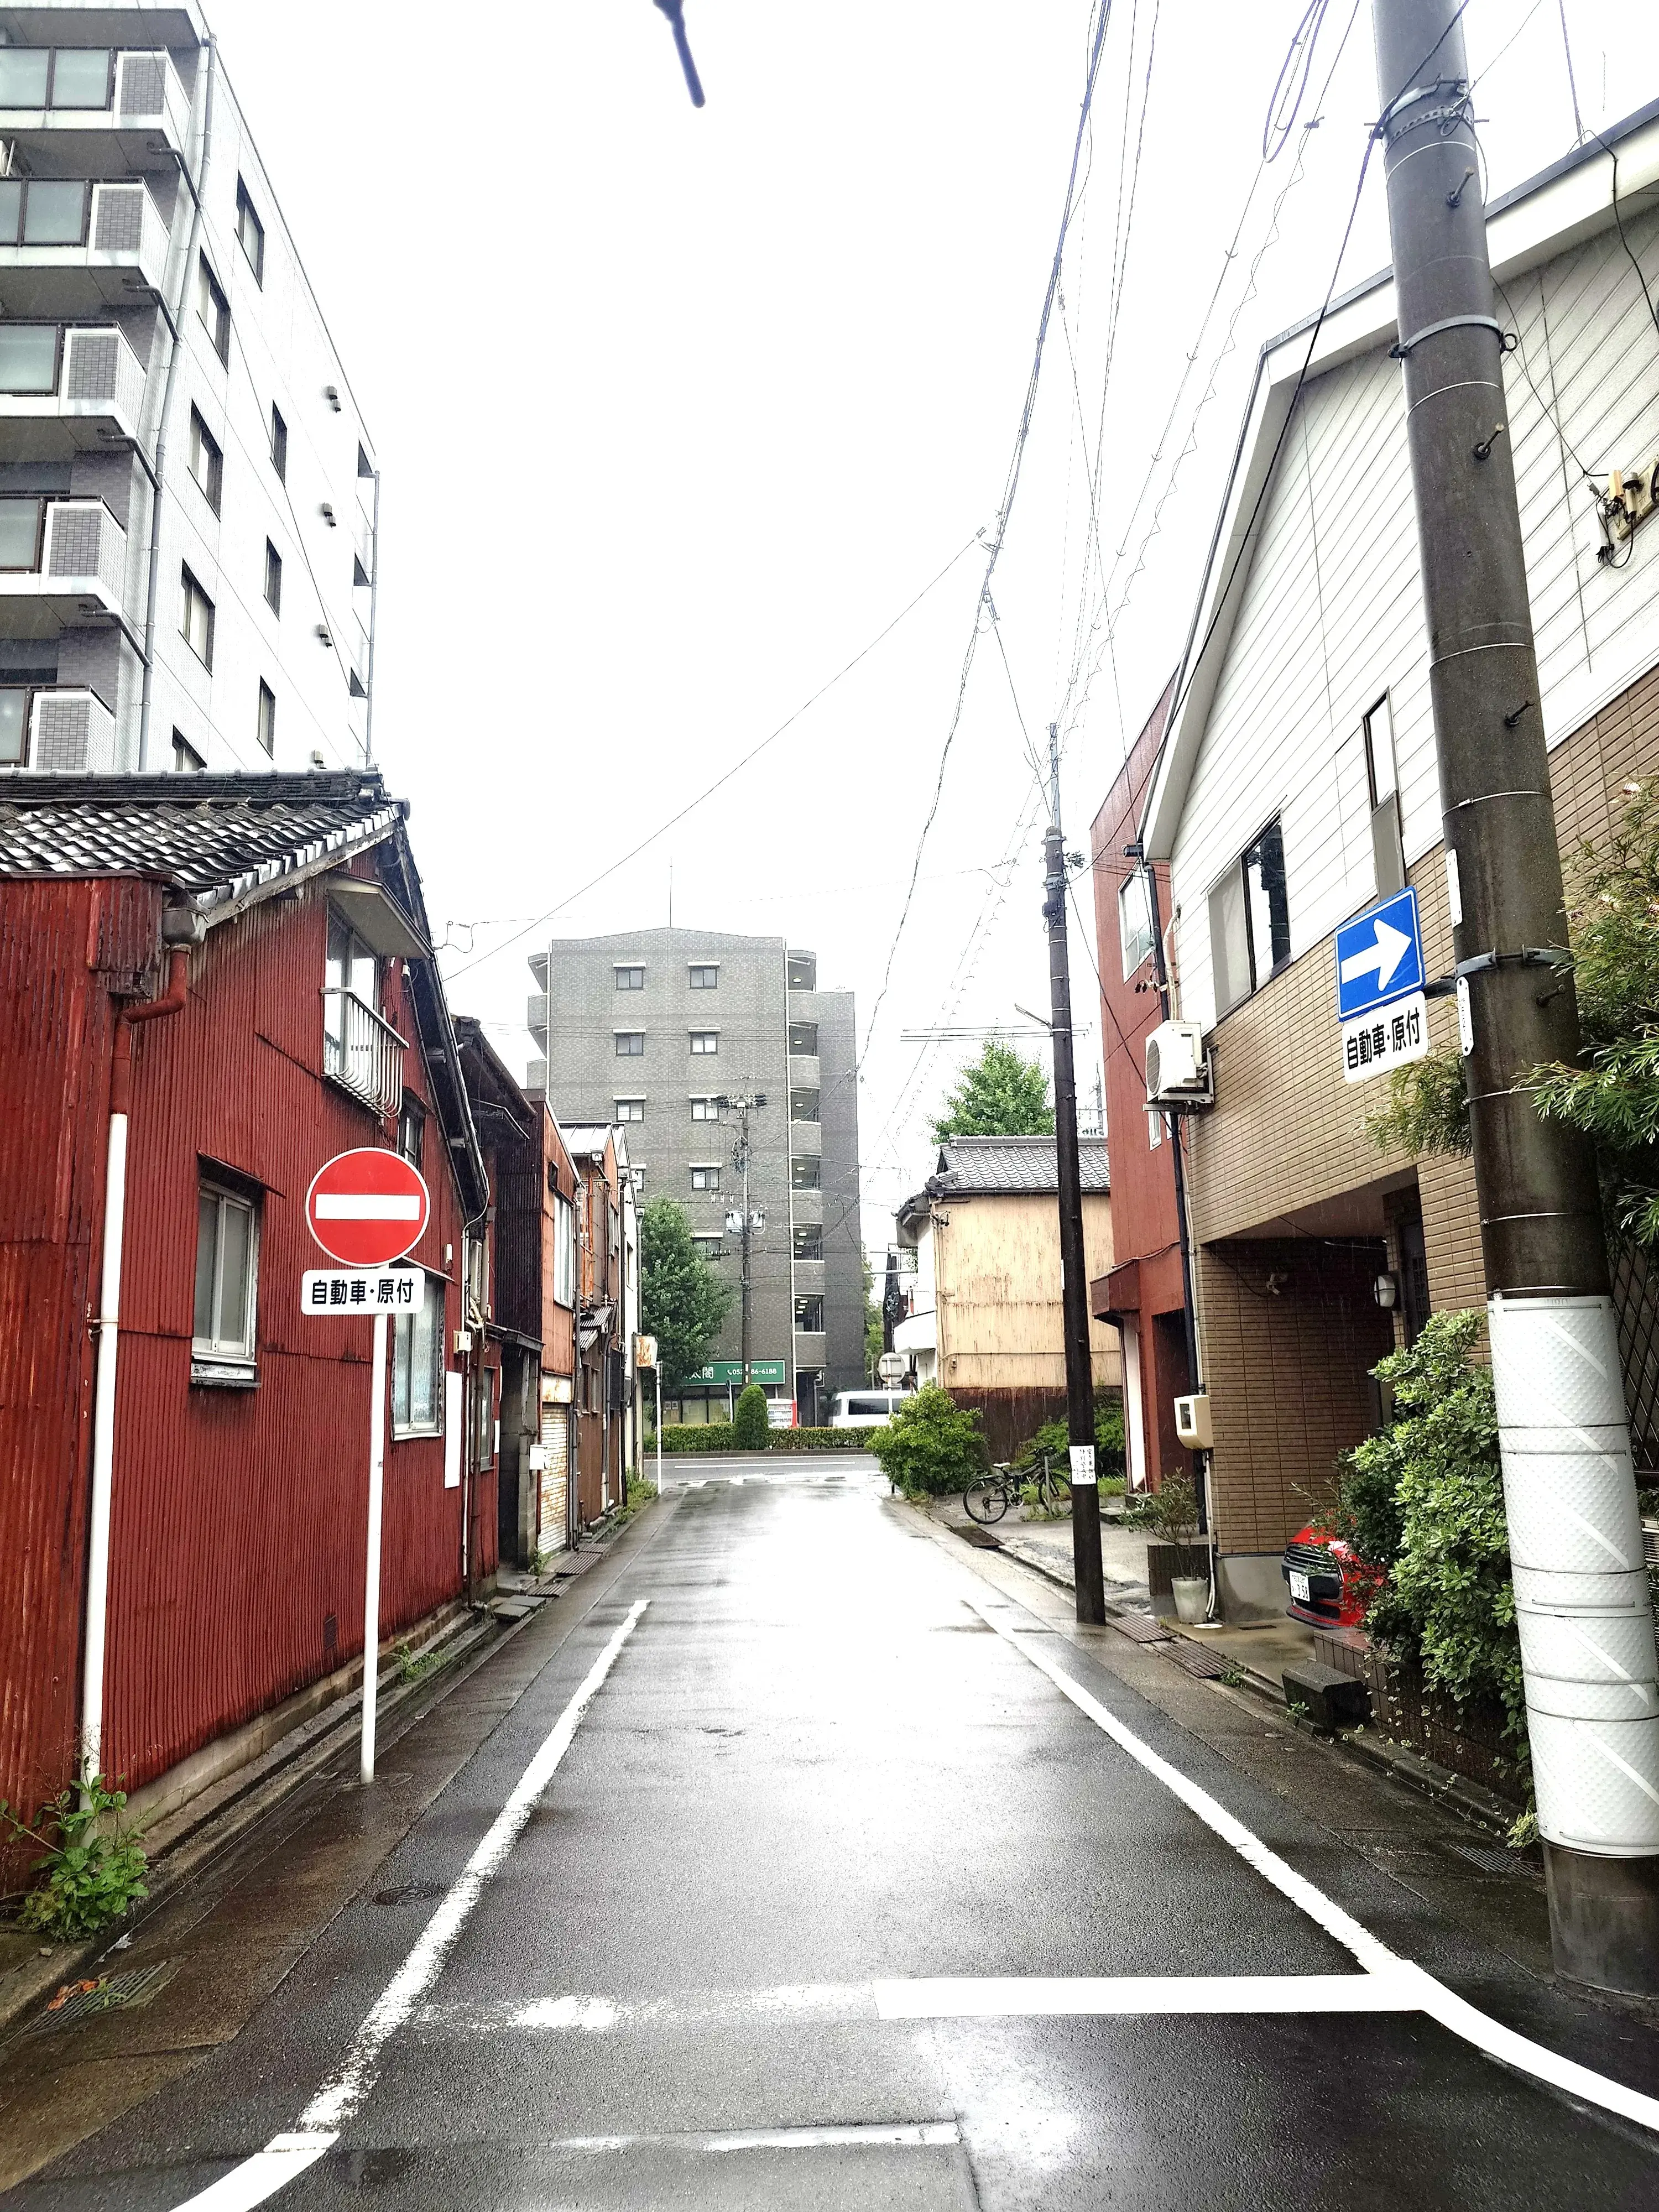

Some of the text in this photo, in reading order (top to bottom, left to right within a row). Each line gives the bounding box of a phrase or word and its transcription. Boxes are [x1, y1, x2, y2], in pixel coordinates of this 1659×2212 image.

[1347, 1008, 1420, 1070] 自動車・原付
[312, 1278, 414, 1305] 自動車・原付
